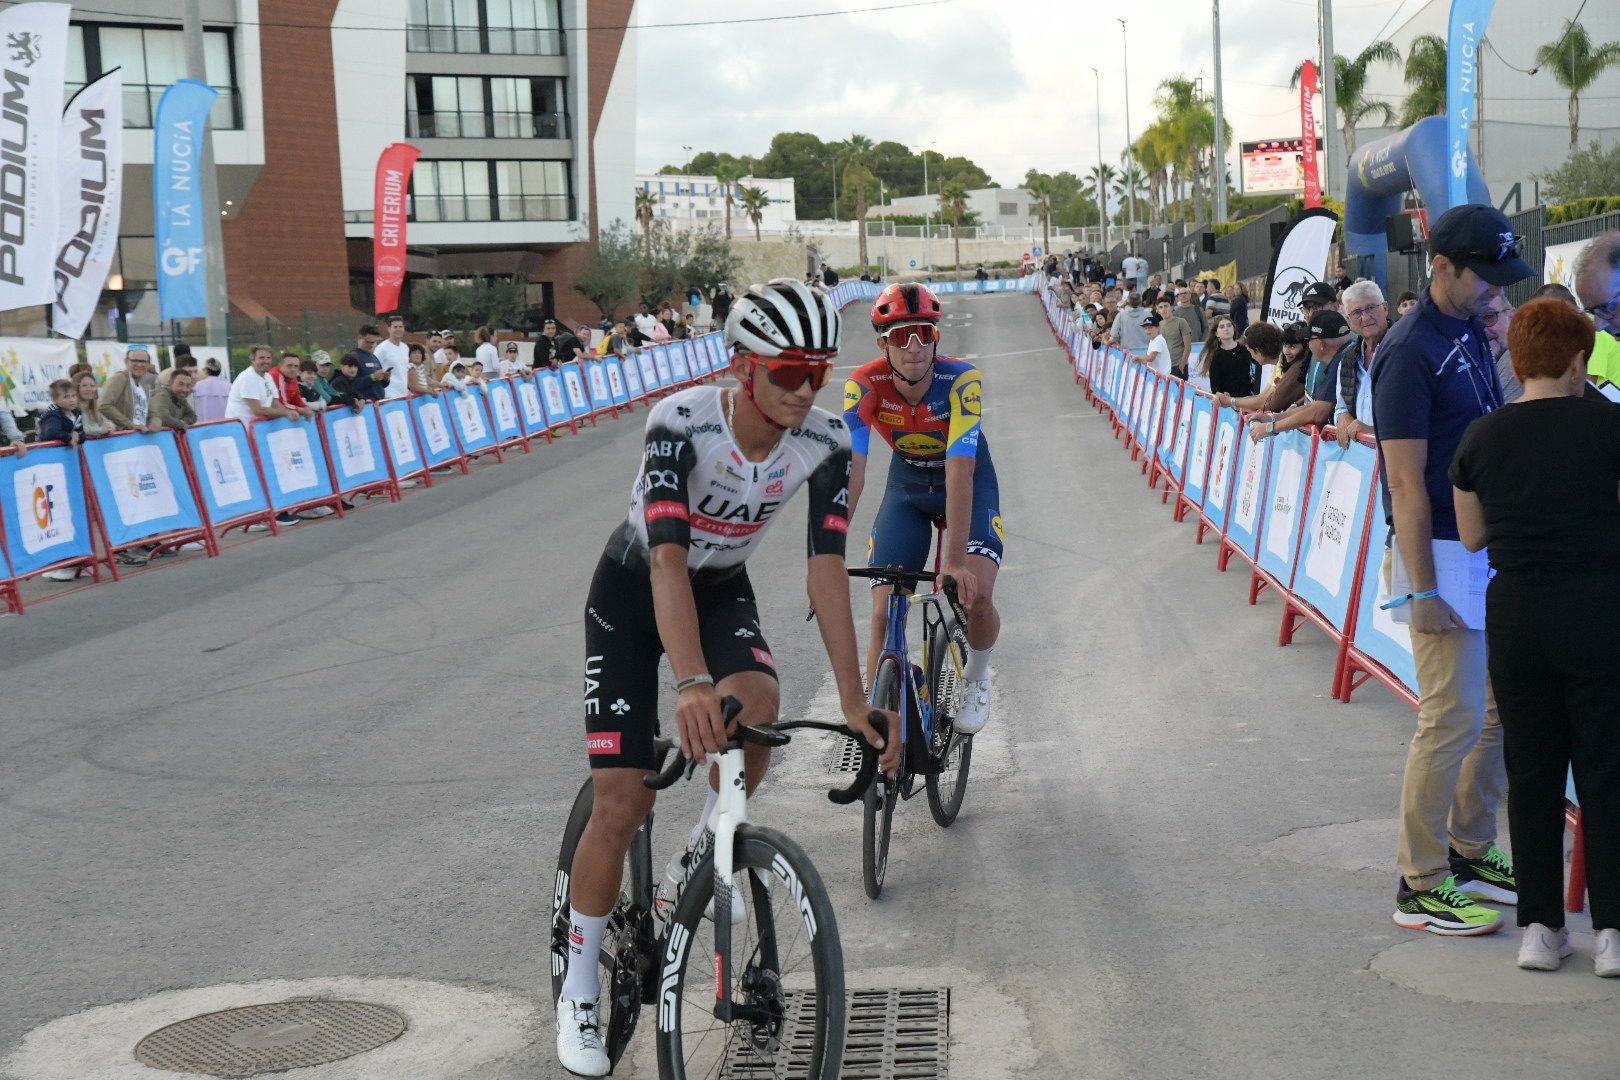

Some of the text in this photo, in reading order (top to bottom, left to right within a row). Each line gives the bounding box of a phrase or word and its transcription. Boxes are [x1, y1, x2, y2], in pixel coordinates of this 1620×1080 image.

[1, 68, 30, 286] PODIUM
[54, 108, 107, 315] PODIUM
[171, 204, 193, 227] LA
[381, 169, 403, 248] CRITERIUM
[691, 422, 722, 435] Analog
[801, 428, 839, 450] Analog
[697, 494, 780, 523] UAE
[584, 654, 604, 716] UAE
[587, 738, 614, 750] rates
